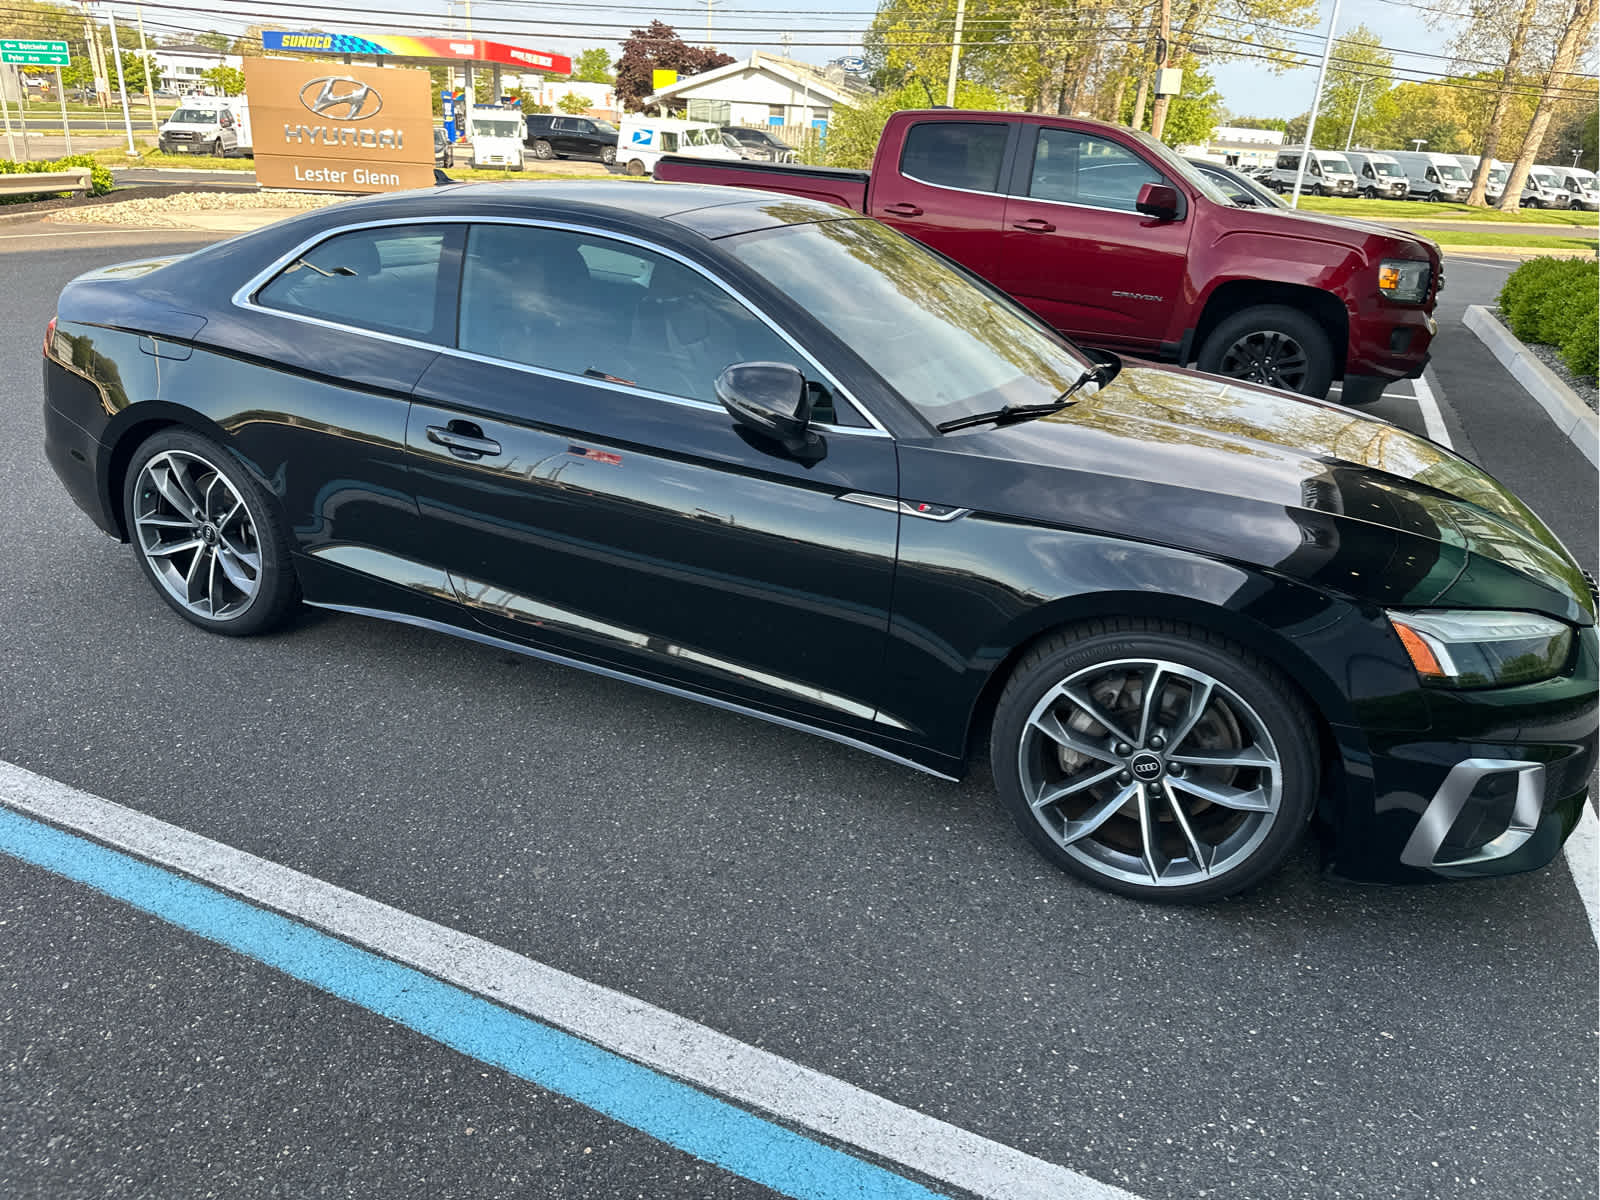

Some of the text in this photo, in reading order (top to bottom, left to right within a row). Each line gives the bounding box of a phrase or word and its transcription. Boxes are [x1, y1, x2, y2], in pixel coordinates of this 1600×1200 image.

[281, 35, 332, 48] SUNOCO
[284, 124, 403, 150] HYUNDAI
[294, 165, 400, 186] Lester Glenn
[1111, 290, 1163, 302] CANYON
